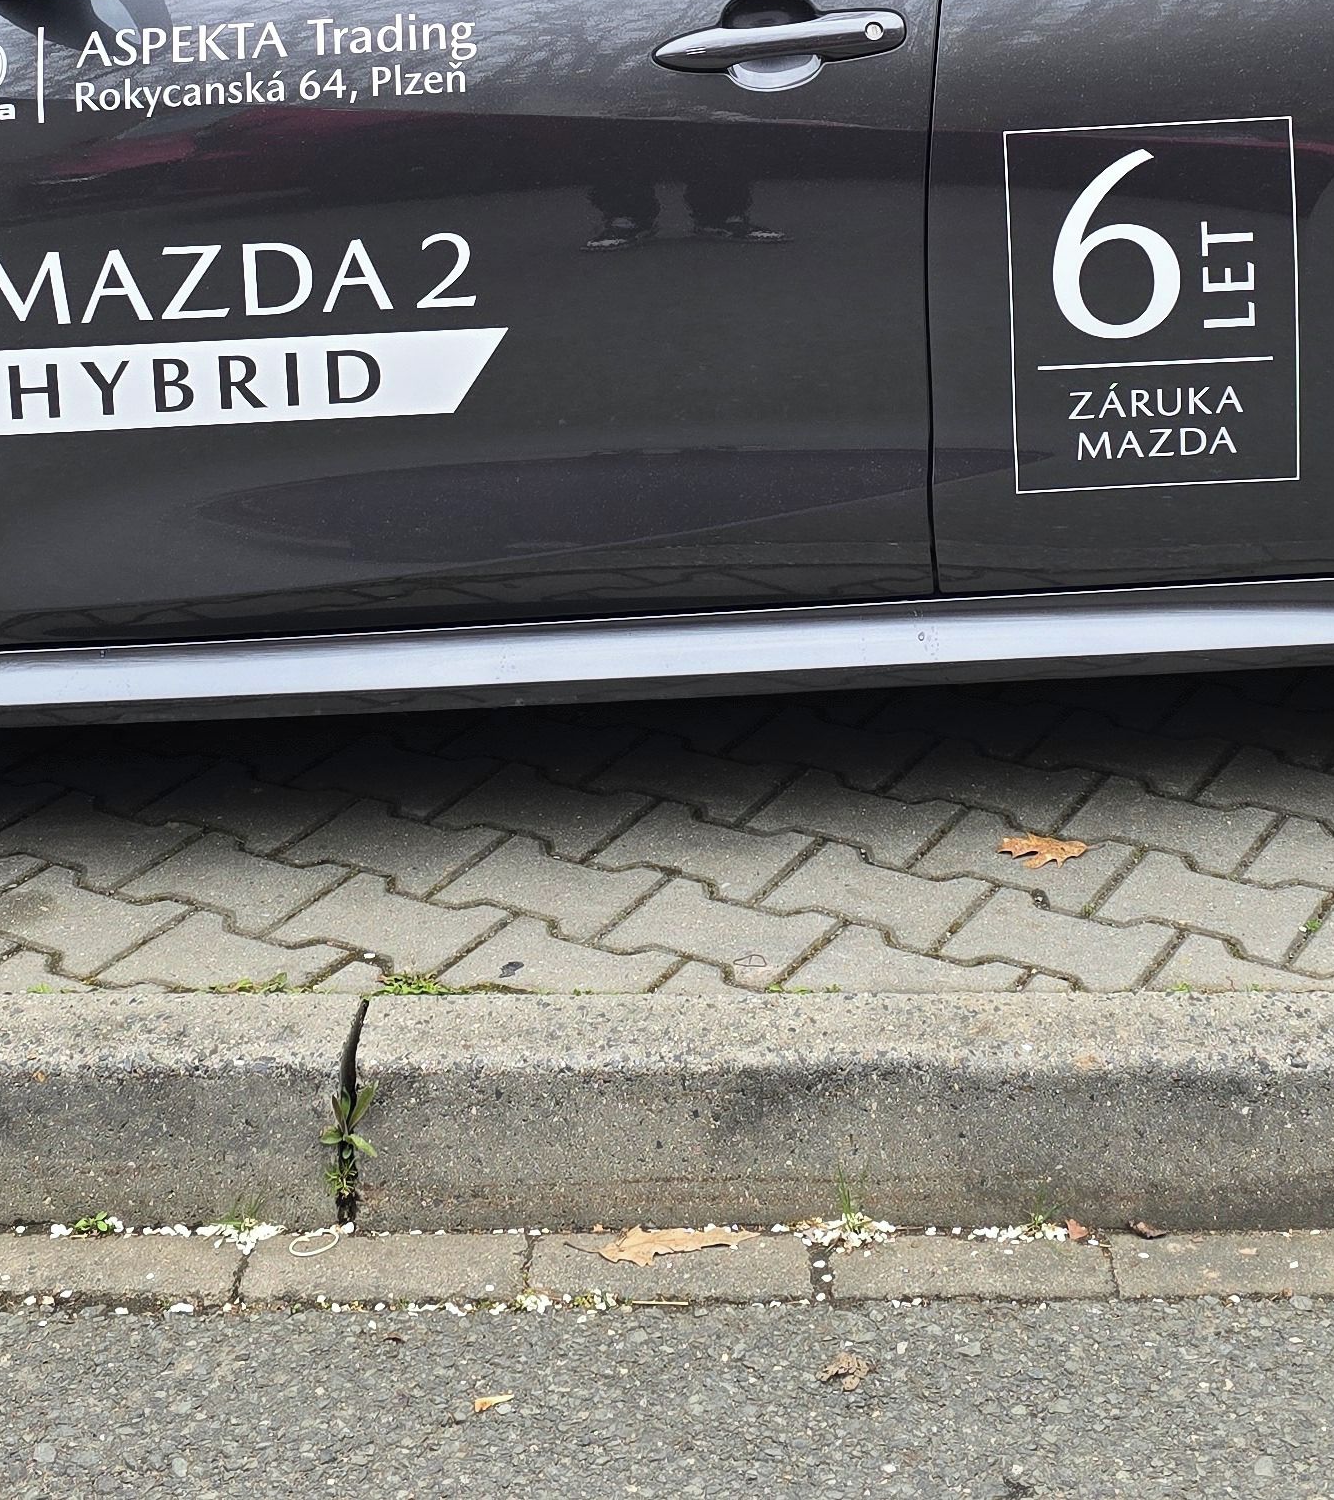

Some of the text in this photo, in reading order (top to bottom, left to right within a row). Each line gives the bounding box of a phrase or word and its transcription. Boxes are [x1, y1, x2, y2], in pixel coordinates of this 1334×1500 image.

[75, 12, 478, 69] ASPEKTA Trading
[74, 61, 466, 118] Rokycanská 64, Plzeň
[416, 232, 477, 309] 2
[1052, 148, 1181, 339] 6
[1200, 221, 1256, 329] LET
[7, 349, 383, 420] HYBRID
[1068, 382, 1244, 420] ZÁRUKA
[1077, 426, 1238, 461] MAZDA
